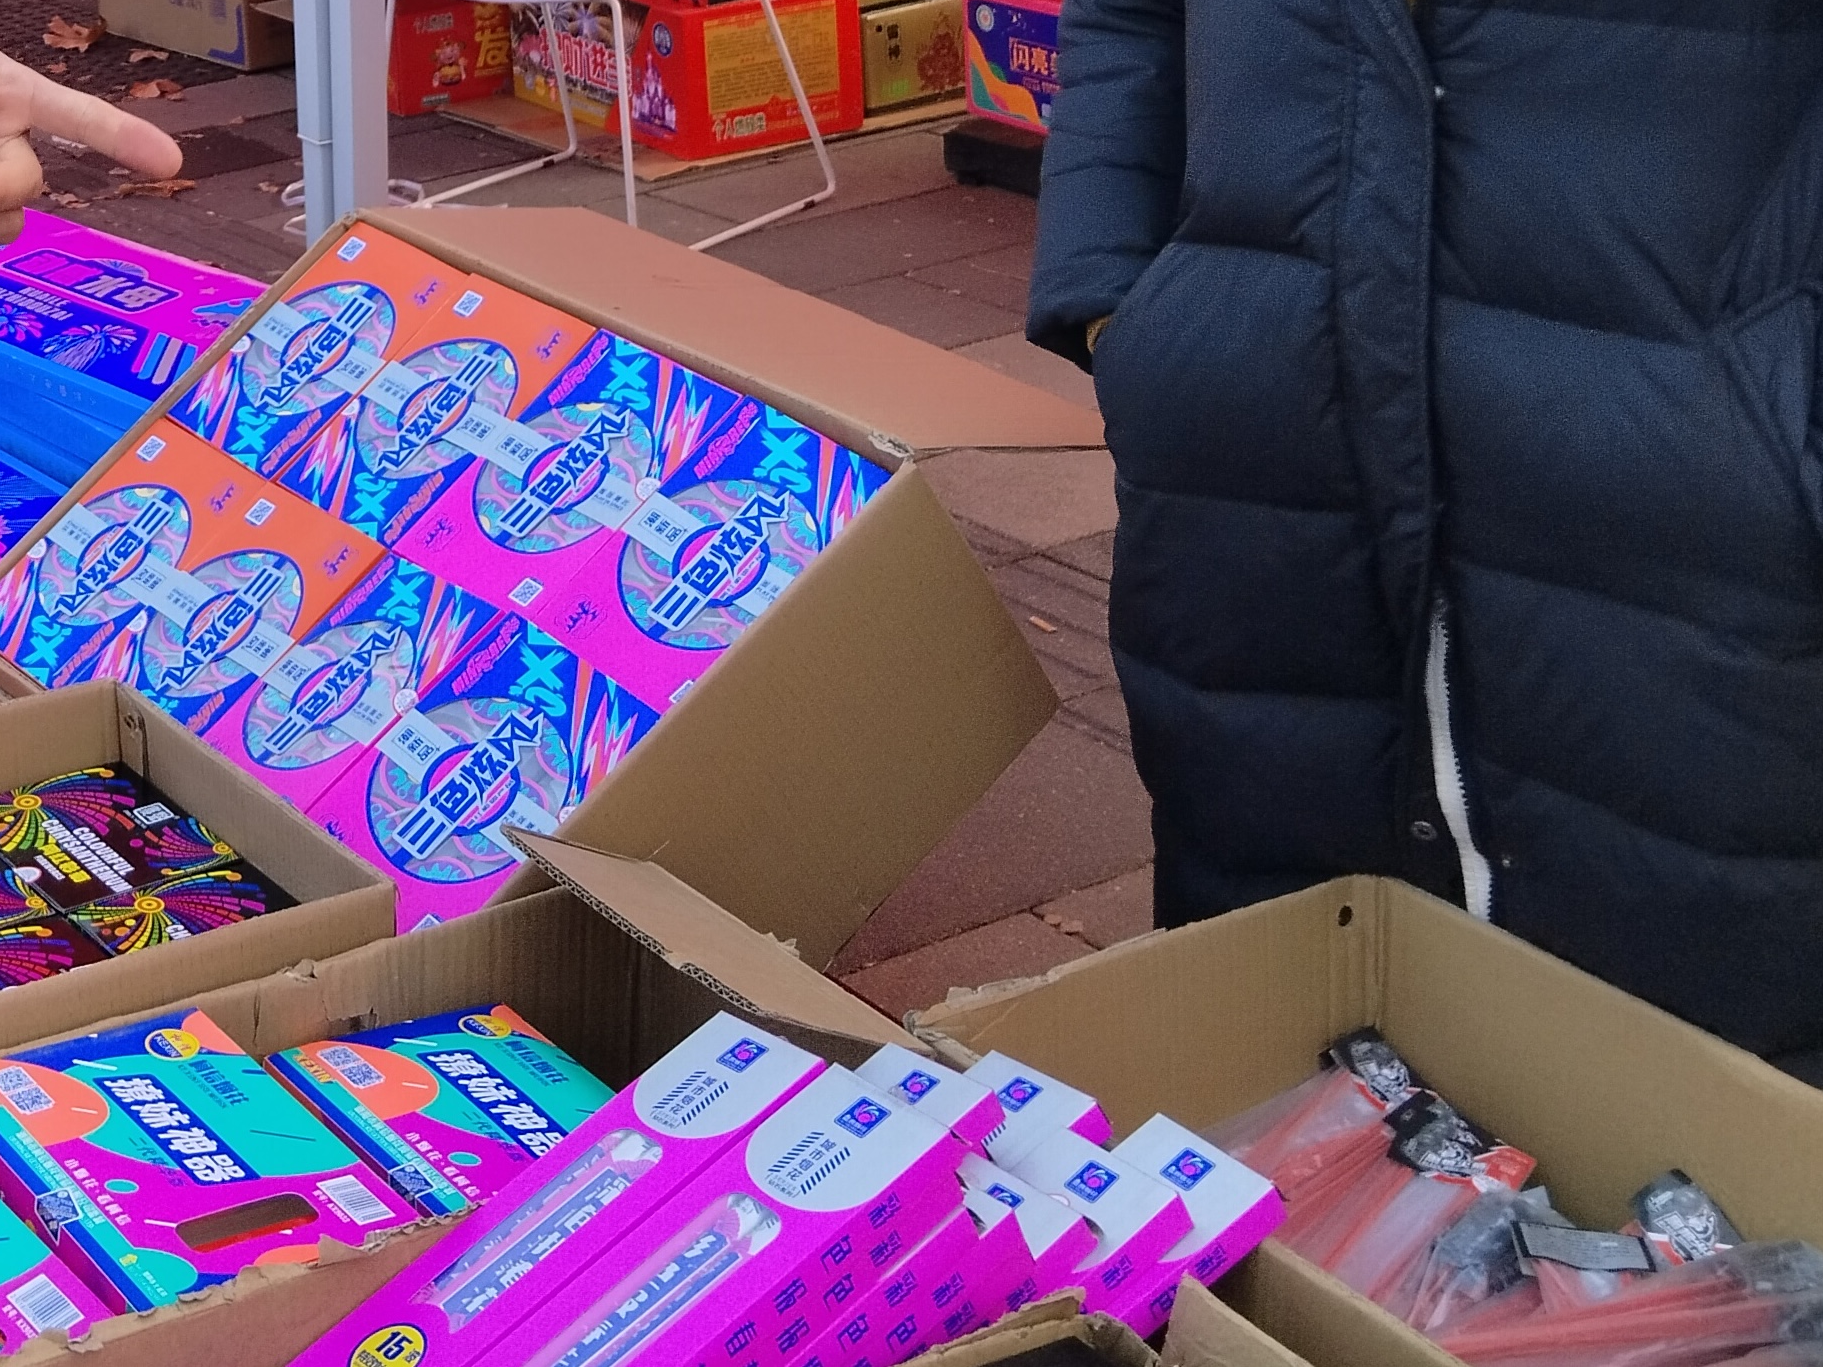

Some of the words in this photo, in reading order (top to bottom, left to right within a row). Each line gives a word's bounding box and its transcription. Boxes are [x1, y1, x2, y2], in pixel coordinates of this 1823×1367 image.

[392, 709, 545, 861] 三色炫风
[73, 827, 135, 875] COLOURFUL
[156, 1033, 181, 1058] KEXIN
[292, 1051, 335, 1084] KEXIN
[427, 1053, 564, 1157] 撩妹神器
[102, 1076, 247, 1184] 撩妹神器
[786, 1138, 837, 1182] 城市烟花
[375, 1331, 414, 1361] 15
